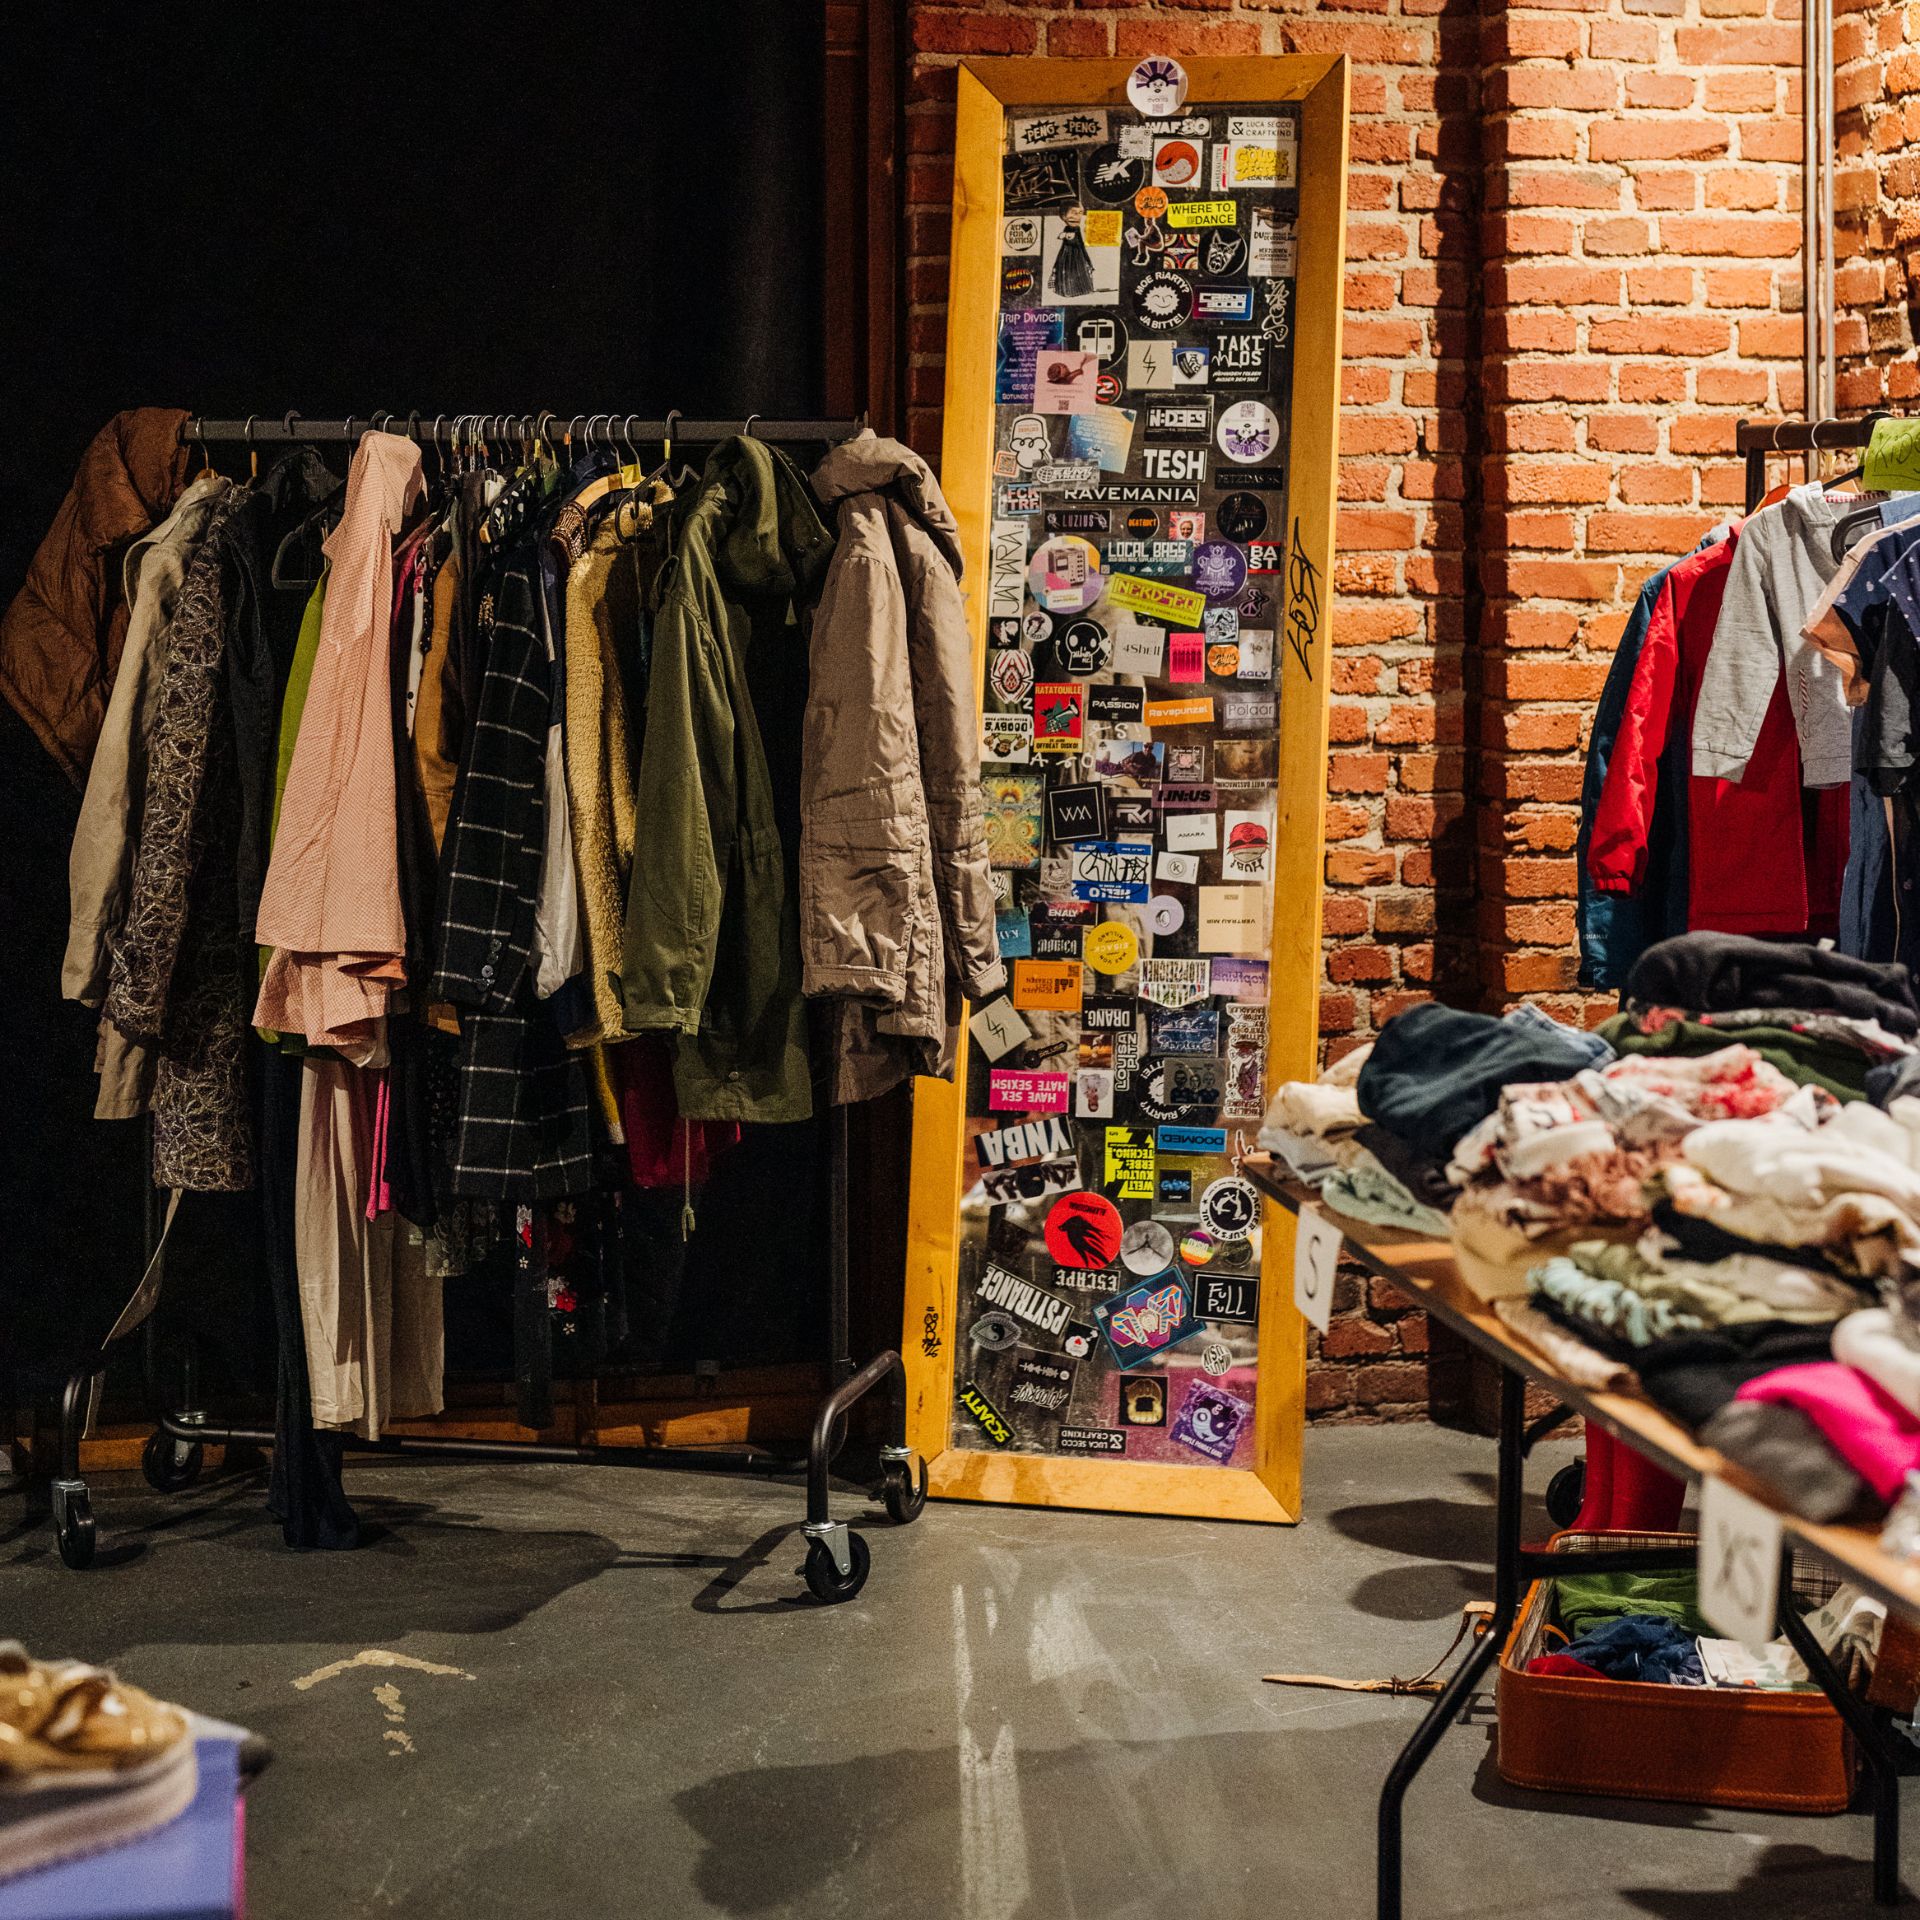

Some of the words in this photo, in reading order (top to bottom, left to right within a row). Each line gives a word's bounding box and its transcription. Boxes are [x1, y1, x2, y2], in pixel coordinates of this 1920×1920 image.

[1171, 204, 1212, 214] WHERE
[1195, 214, 1234, 224] DANCE
[1135, 275, 1154, 295] MOE
[1140, 315, 1152, 326] JA
[1217, 335, 1264, 351] TAKT
[1228, 350, 1262, 367] LOS
[1143, 448, 1205, 480] TESH
[1007, 487, 1039, 498] FCK
[1064, 486, 1196, 501] RAVEMANIA
[1108, 541, 1149, 557] LOCAL
[1153, 541, 1187, 558] BASS
[1251, 545, 1278, 558] BA
[1250, 558, 1276, 569] ST
[1035, 686, 1082, 694] RATATOUILLE
[1092, 700, 1140, 710] PASSION
[1089, 887, 1131, 900] HELLO
[1084, 1008, 1130, 1027] DRANG.
[1127, 1032, 1137, 1069] PITZ
[1116, 1032, 1128, 1089] LOUISA
[991, 1079, 1033, 1089] SEXISM
[1037, 1080, 1067, 1092] HATE
[1002, 1091, 1022, 1102] SEX
[1028, 1092, 1057, 1103] HAVE
[980, 1117, 1071, 1166] YNBA
[1161, 1133, 1224, 1146] DOOMED.
[1112, 1148, 1154, 1159] TECHNO.
[1125, 1160, 1154, 1170] ERBE:
[1115, 1170, 1154, 1180] KULTUR
[1127, 1180, 1154, 1191] WELT
[1246, 1187, 1262, 1230] MACKER
[1202, 1209, 1220, 1235] MAUL
[1304, 1234, 1321, 1299] S
[1055, 1269, 1119, 1292] ESCAPE
[976, 1265, 1071, 1336] PSYTRANCE
[960, 1390, 1010, 1443] SCRAFTY
[1061, 1430, 1108, 1439] CRAFTKIND
[1061, 1440, 1087, 1448] SECCO
